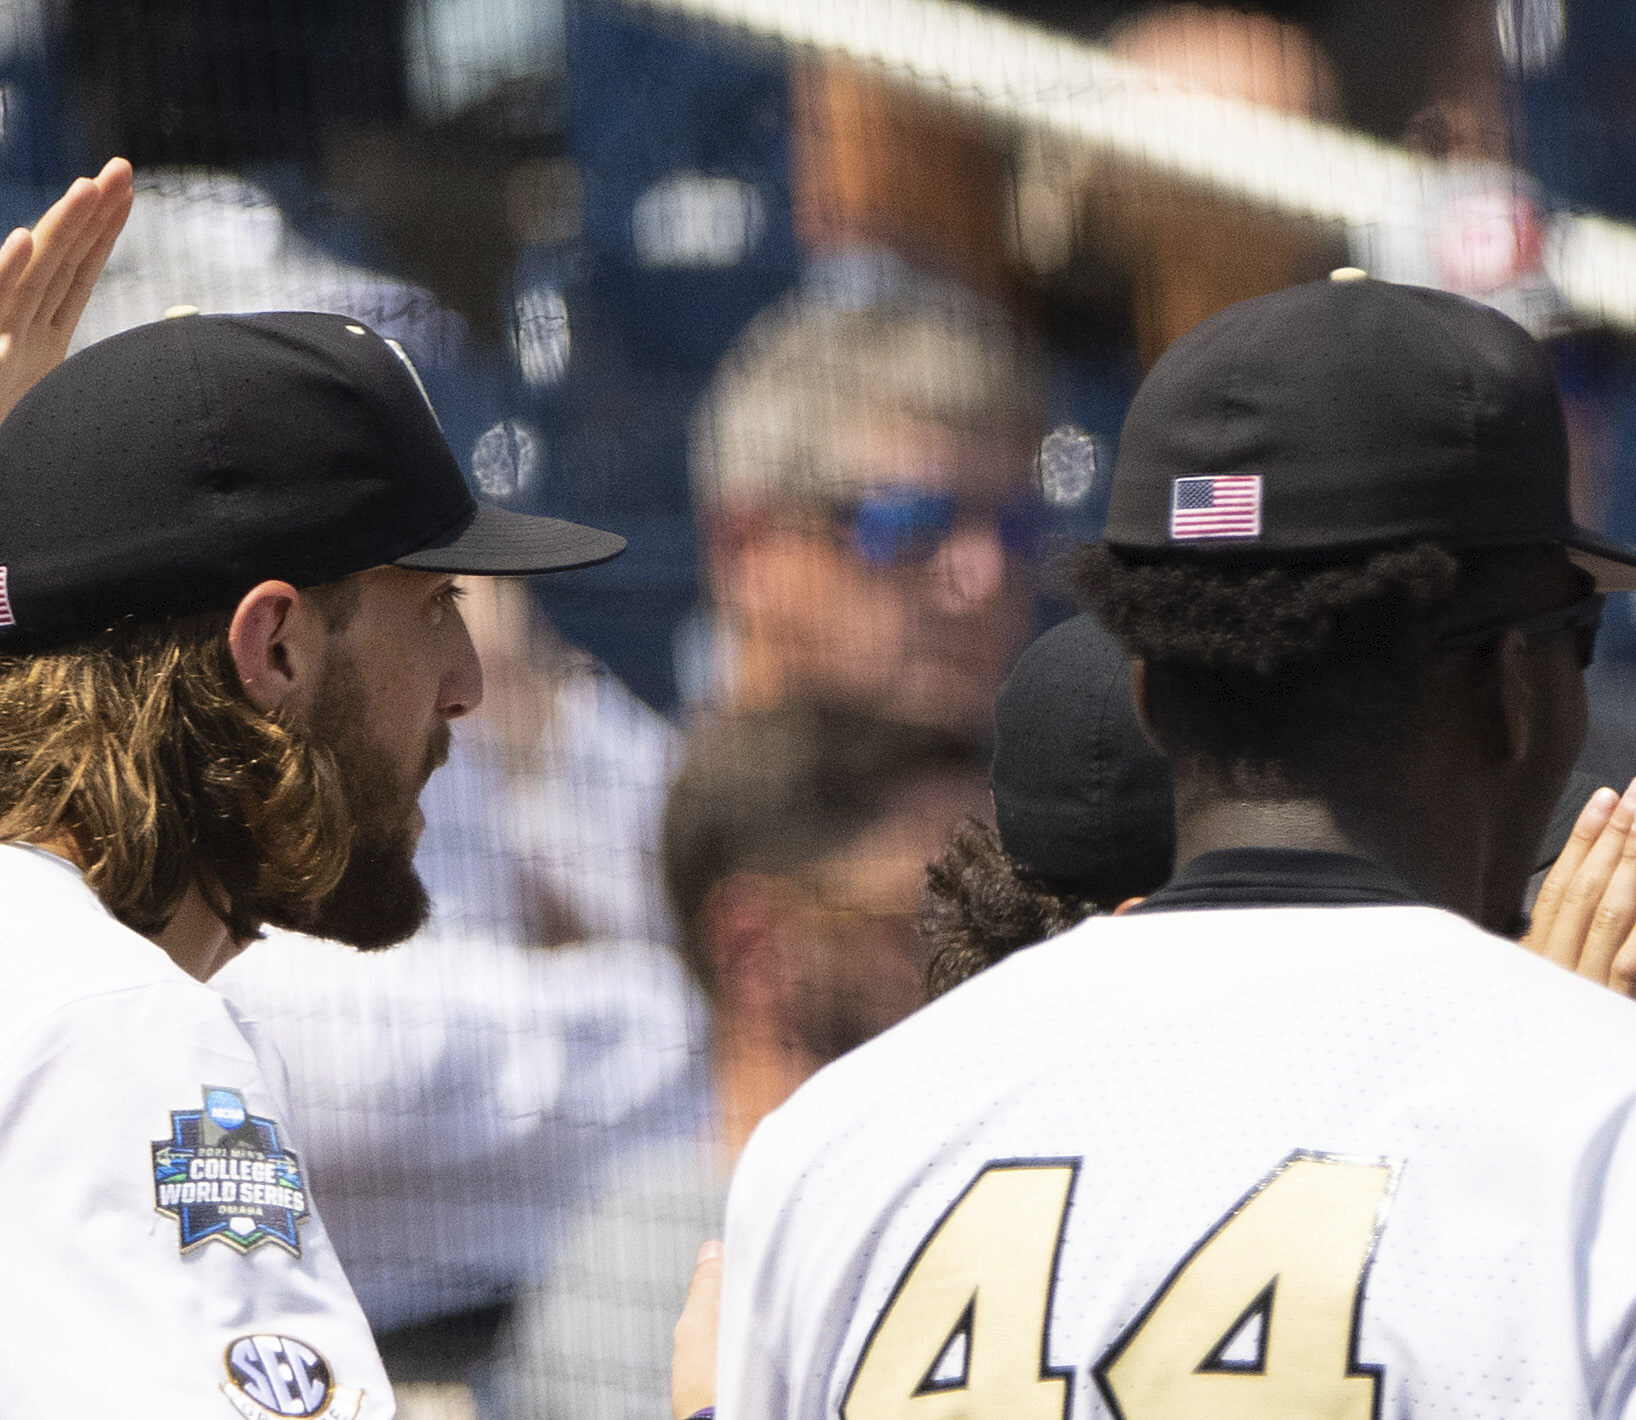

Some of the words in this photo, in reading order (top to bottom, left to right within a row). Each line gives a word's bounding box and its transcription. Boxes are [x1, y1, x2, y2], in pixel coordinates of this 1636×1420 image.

[189, 1159, 276, 1185] COLLEGE
[159, 1180, 237, 1206] WORLD
[239, 1182, 304, 1212] SERIES
[217, 1205, 263, 1216] OMAHA
[231, 1336, 326, 1415] SEC
